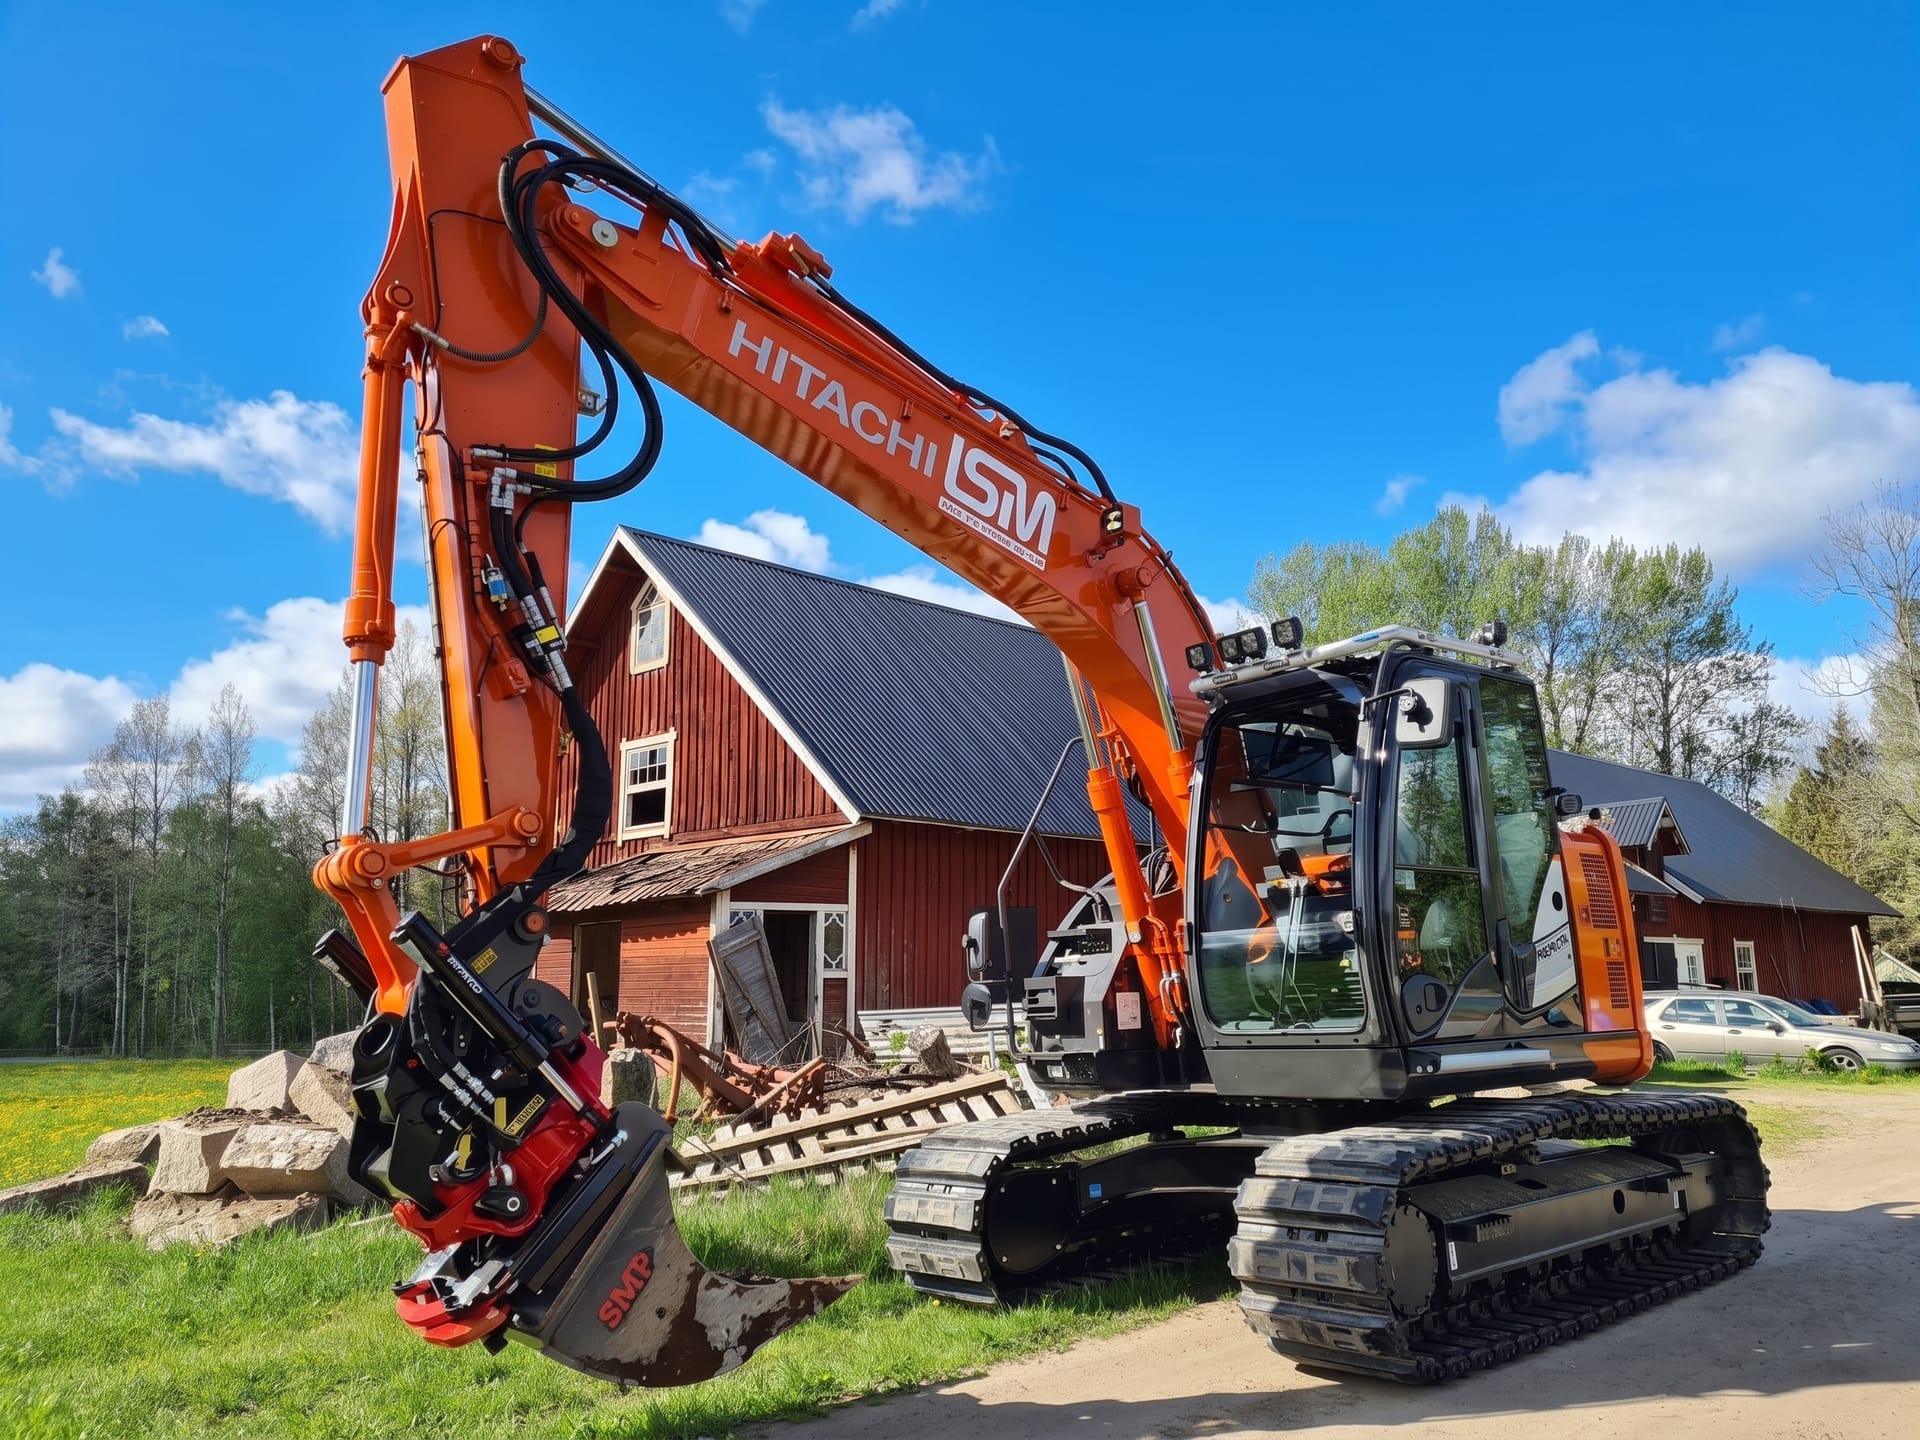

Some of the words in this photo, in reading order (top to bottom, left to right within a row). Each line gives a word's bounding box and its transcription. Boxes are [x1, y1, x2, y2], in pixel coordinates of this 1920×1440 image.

[727, 319, 938, 478] HITACHI
[943, 432, 1057, 556] LSM
[598, 1251, 652, 1330] SMP
